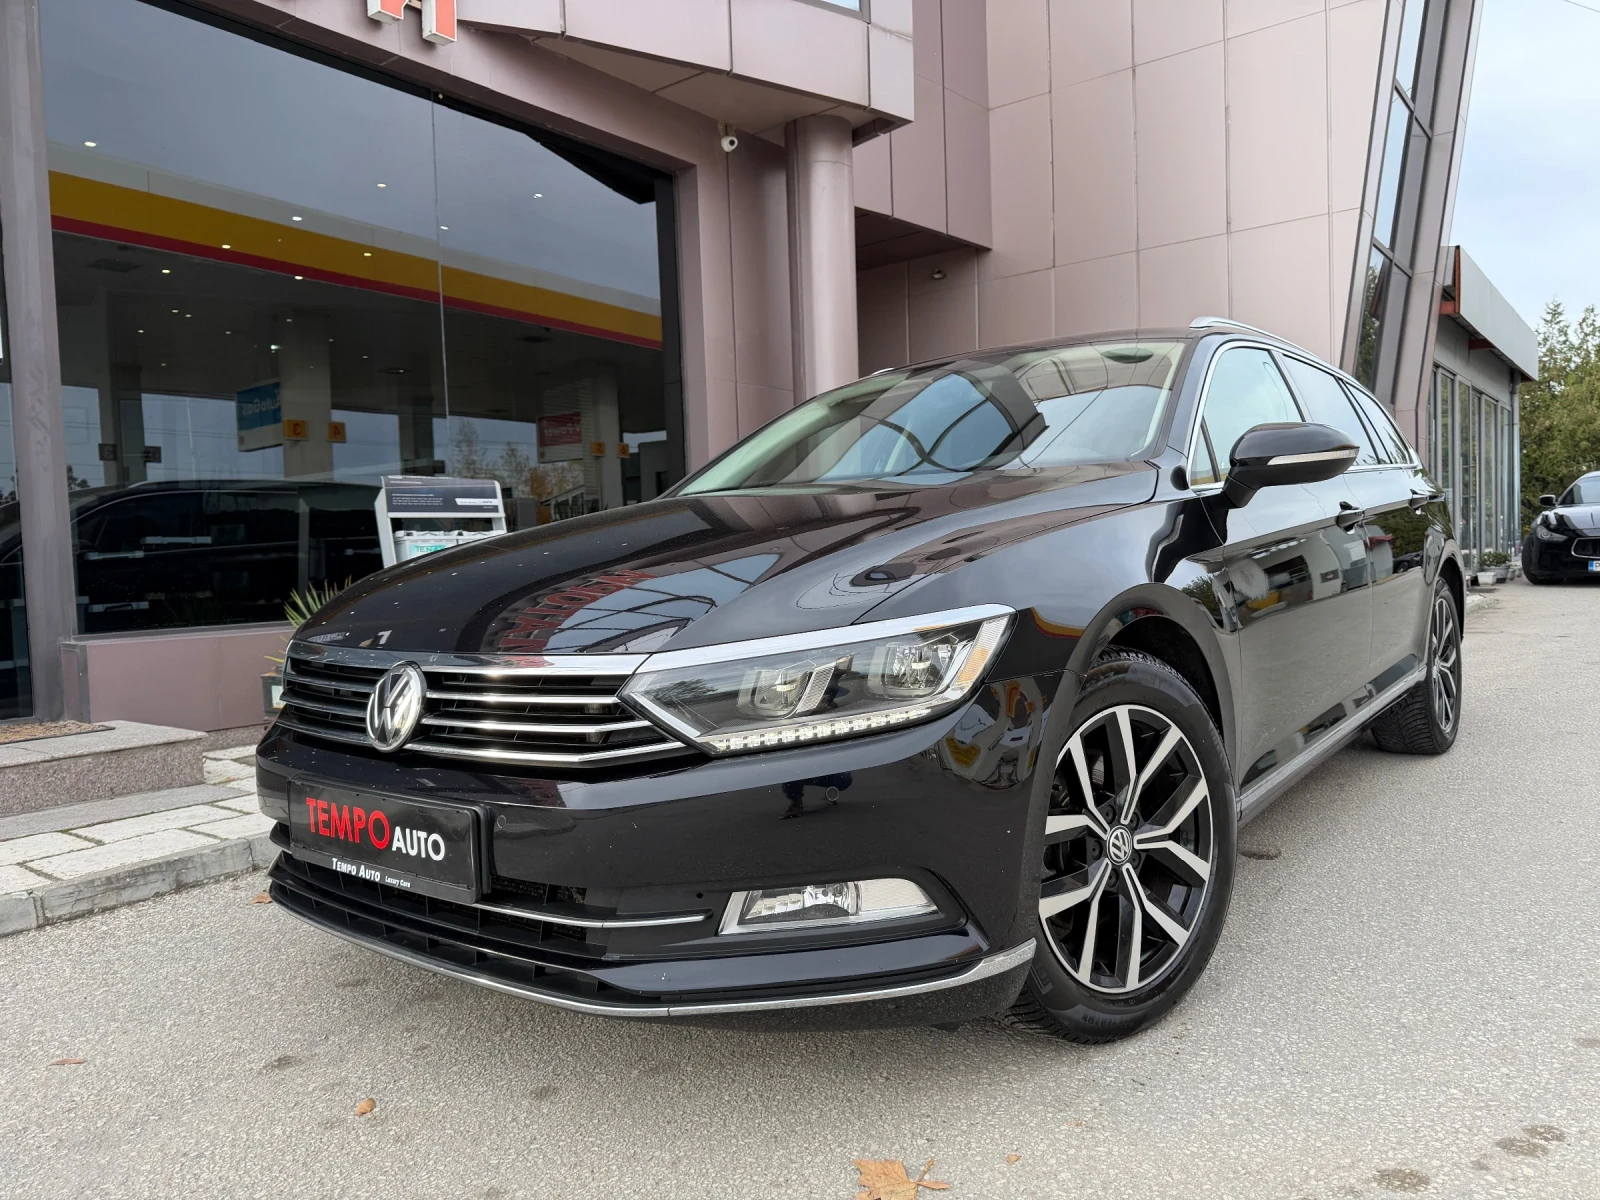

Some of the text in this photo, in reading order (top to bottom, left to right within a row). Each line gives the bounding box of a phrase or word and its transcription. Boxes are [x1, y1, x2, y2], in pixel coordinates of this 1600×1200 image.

[306, 797, 446, 861] TEMPO AUTO
[332, 857, 411, 888] TEMPO AUTO Luxury Cars
